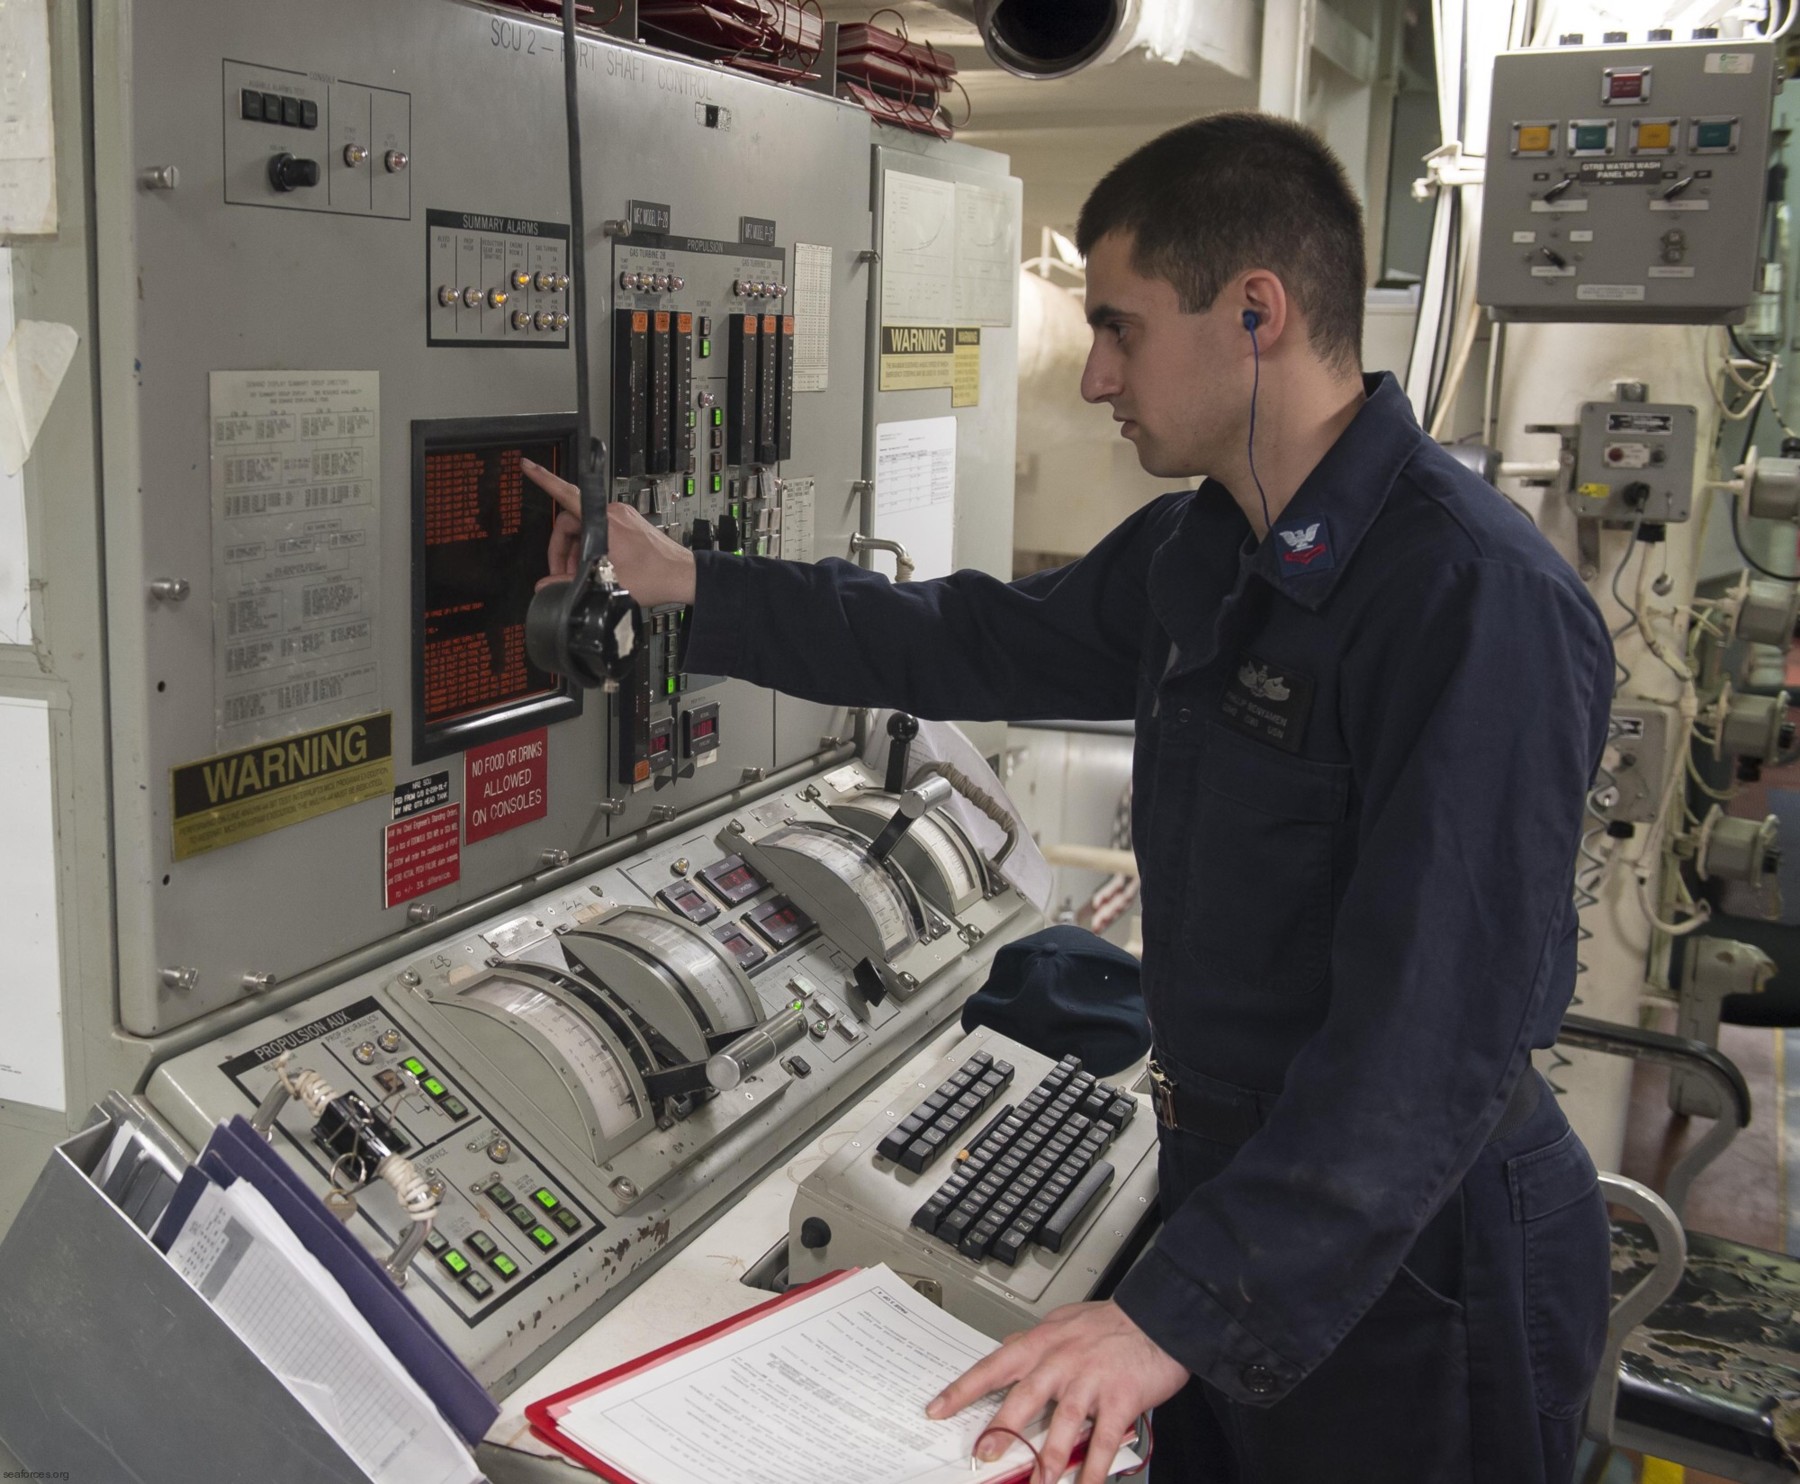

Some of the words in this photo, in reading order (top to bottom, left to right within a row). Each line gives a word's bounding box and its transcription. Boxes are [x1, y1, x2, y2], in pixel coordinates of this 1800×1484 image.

[490, 18, 521, 51] SCU
[527, 29, 536, 55] 2
[607, 49, 647, 83] SHAFT
[657, 66, 712, 101] CONTROL
[309, 71, 336, 84] CONSOLE
[1597, 171, 1624, 179] PANEL
[1625, 171, 1637, 179] NO
[1638, 170, 1644, 178] 2
[1606, 162, 1635, 171] WATER
[1637, 161, 1660, 170] WASH
[462, 214, 504, 232] SUMMARY
[506, 220, 539, 235] ALARMS
[630, 248, 639, 257] GAS
[639, 249, 660, 259] TURBINE
[686, 239, 724, 252] PROPULSION
[742, 259, 750, 267] GAS
[751, 260, 766, 268] TURBINE
[891, 328, 947, 353] WARNING
[202, 724, 368, 804] WARNING
[472, 759, 483, 778] NO
[484, 752, 505, 773] FOOD
[506, 749, 517, 766] OR
[518, 740, 543, 763] DRINKS
[278, 797, 292, 807] TEST
[292, 787, 323, 802] INTERRUPTS
[335, 777, 359, 790] PROGRAM
[359, 767, 389, 784] EXECUTION
[422, 778, 432, 787] SCU
[483, 768, 532, 798] ALLOWED
[394, 796, 403, 805] FED
[403, 792, 416, 802] FROM
[394, 806, 401, 815] BY
[424, 795, 436, 805] HEAD
[436, 791, 447, 801] TANK
[472, 807, 487, 827] ON
[490, 788, 542, 820] CONSOLES
[224, 825, 236, 834] MCS
[237, 815, 265, 830] PROGRAM
[254, 1023, 328, 1061] PROPULSION
[325, 1011, 352, 1030] AUX
[324, 1031, 341, 1043] PROP
[342, 1014, 380, 1036] HYDRAULICS
[423, 1147, 448, 1166] SERVICE
